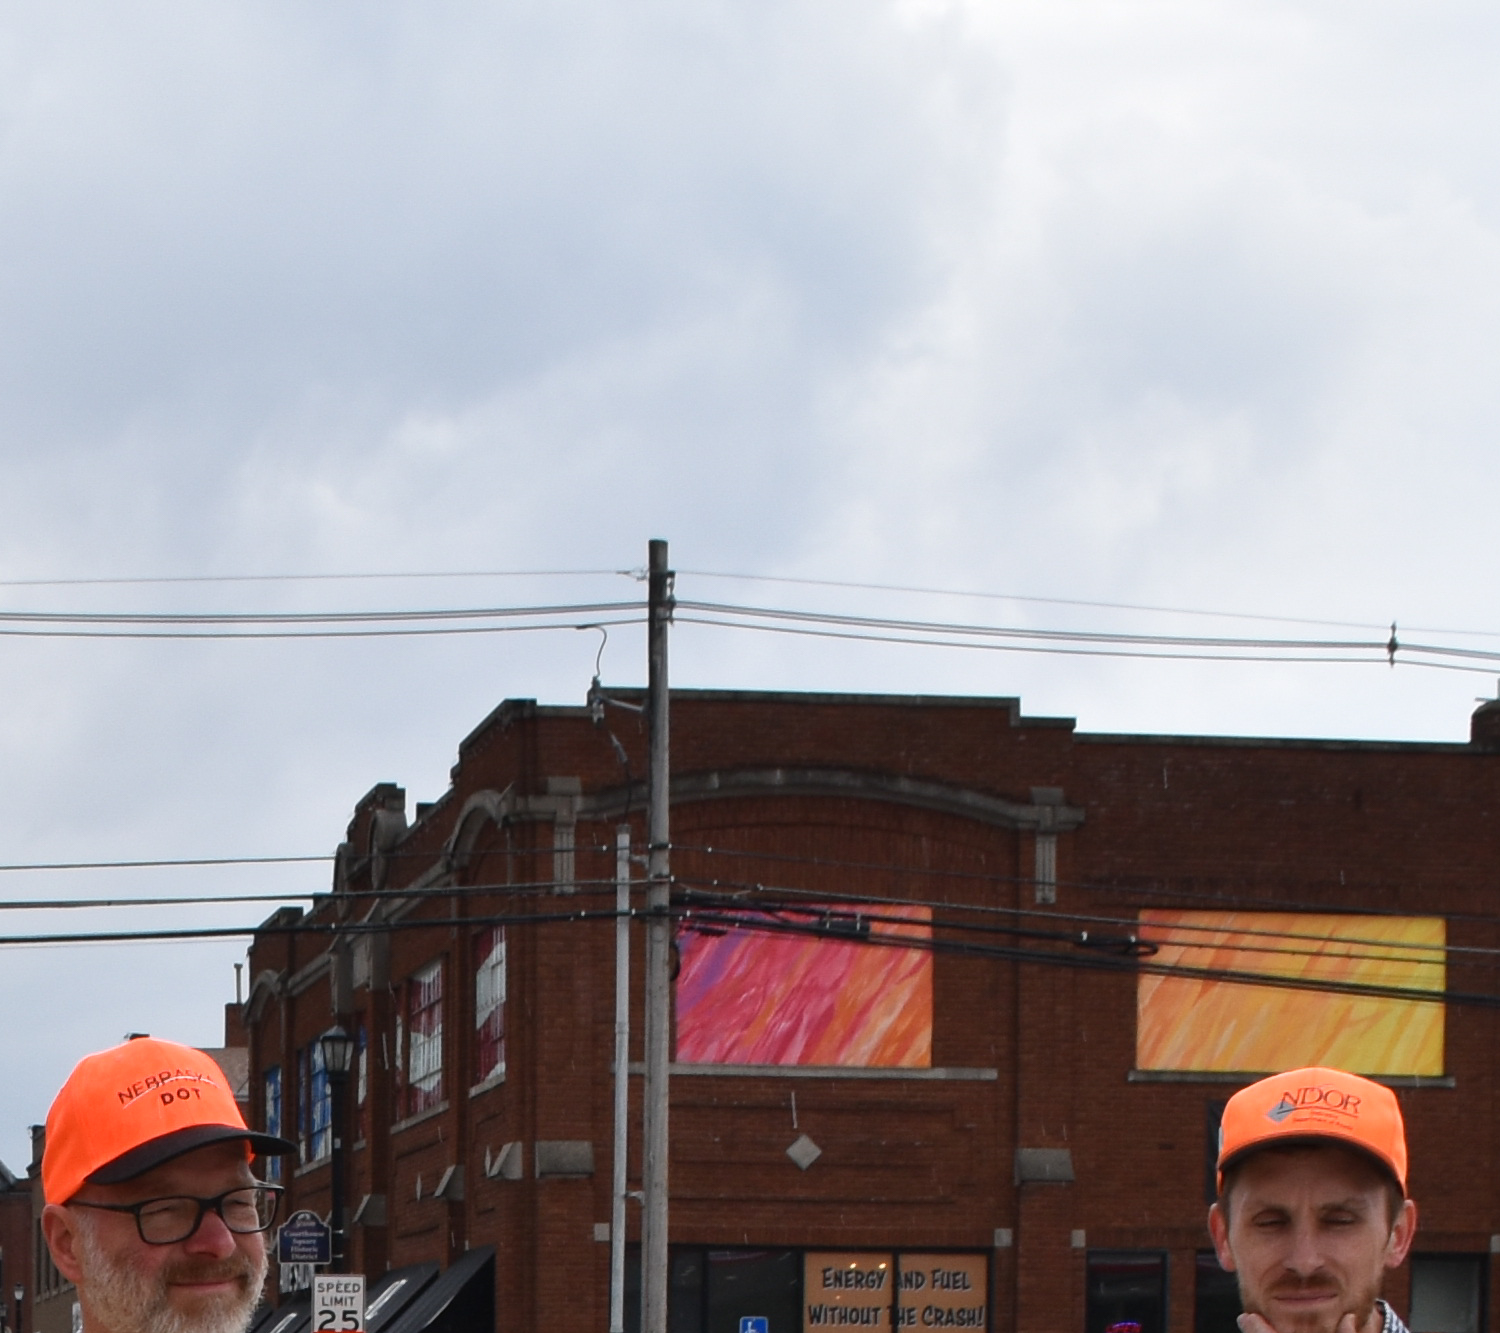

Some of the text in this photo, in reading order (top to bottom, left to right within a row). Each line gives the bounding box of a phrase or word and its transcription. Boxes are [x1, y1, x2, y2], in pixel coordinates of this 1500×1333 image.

[160, 1087, 201, 1106] DOT
[1278, 1086, 1361, 1114] NDOR
[317, 1282, 361, 1294] SPEED
[321, 1296, 356, 1307] LIMIT
[318, 1309, 360, 1333] 25
